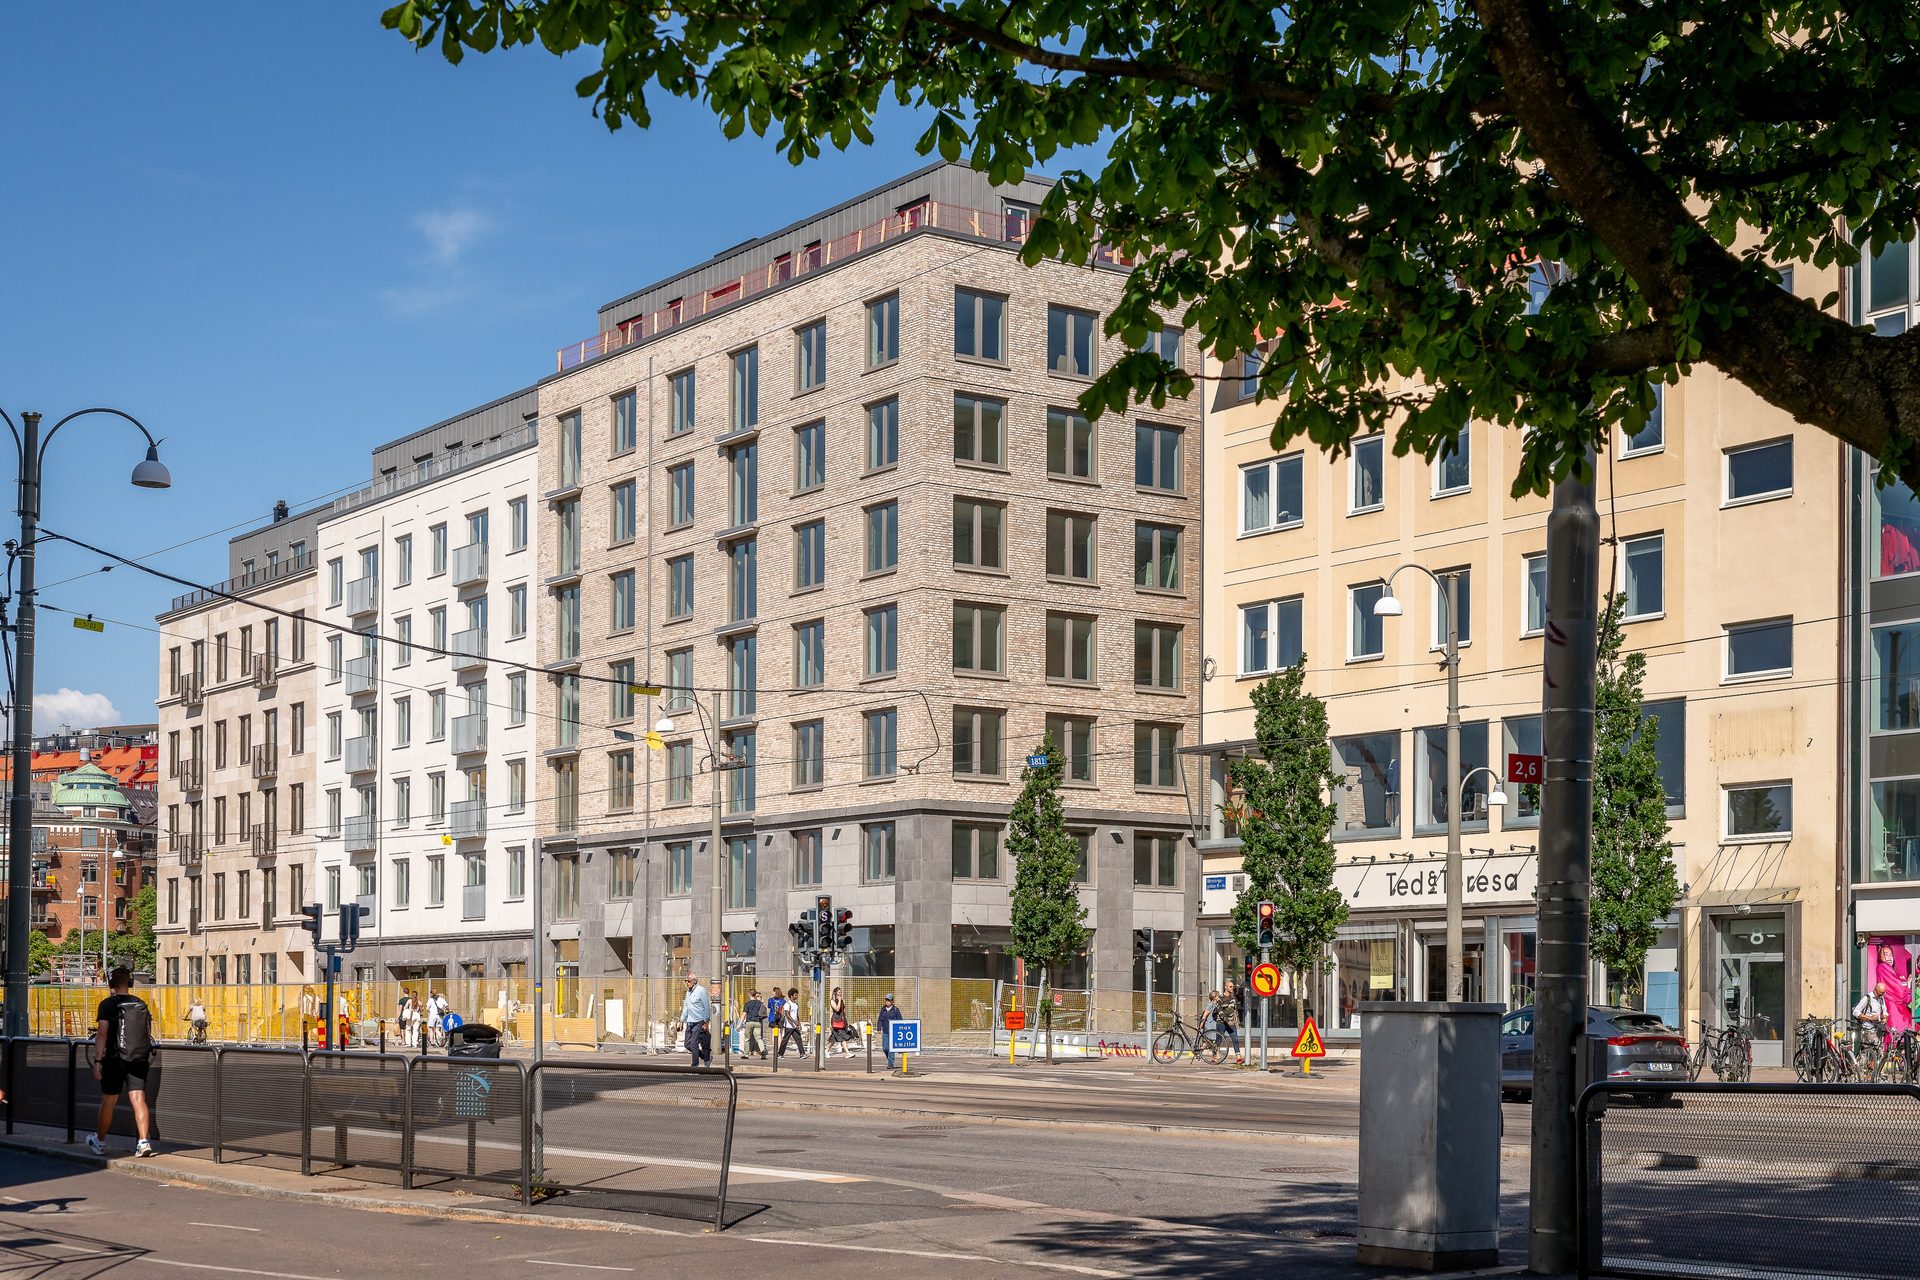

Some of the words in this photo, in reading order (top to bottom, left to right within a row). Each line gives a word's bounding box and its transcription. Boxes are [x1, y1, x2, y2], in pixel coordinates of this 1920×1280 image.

[1031, 757, 1045, 765] 1811
[1515, 761, 1537, 780] 2,6
[1386, 871, 1423, 896] Ted
[1427, 870, 1437, 894] &
[1440, 870, 1518, 893] Tresa
[897, 1031, 913, 1041] 30
